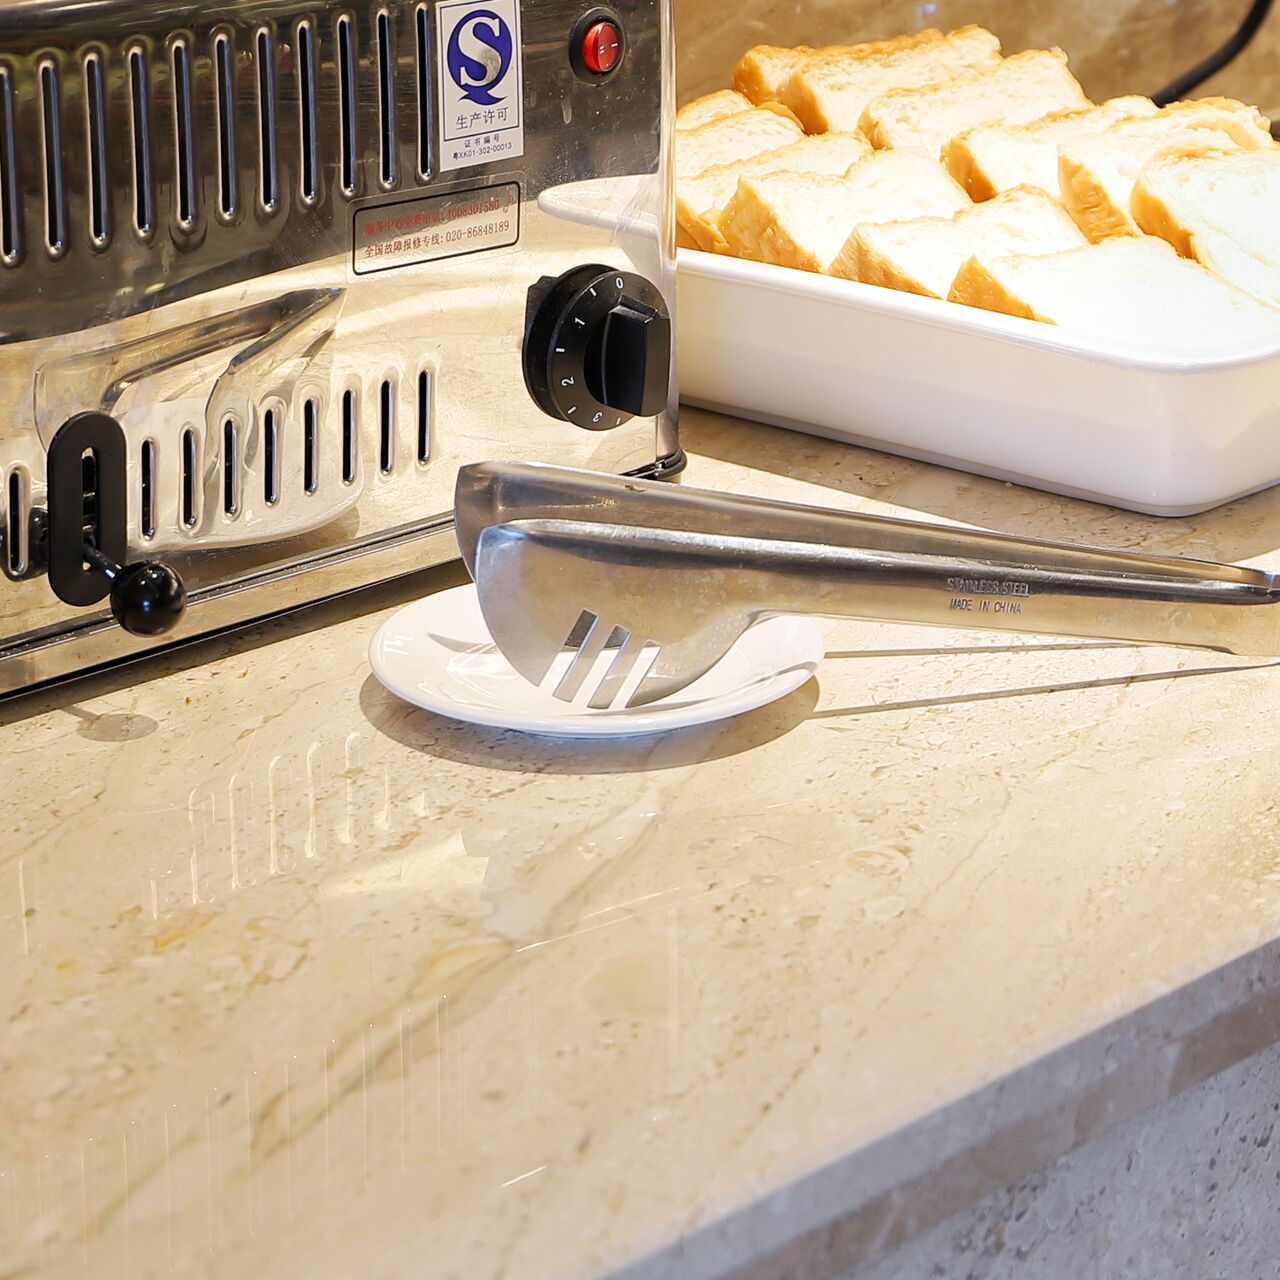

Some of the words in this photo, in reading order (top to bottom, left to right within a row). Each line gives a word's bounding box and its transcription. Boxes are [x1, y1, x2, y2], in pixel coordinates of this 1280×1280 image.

[456, 106, 509, 131] 生产许可
[615, 277, 625, 289] 0
[574, 318, 586, 327] 1
[561, 376, 575, 387] 2
[592, 412, 603, 422] 3
[947, 577, 999, 595] STAINLESS
[1002, 581, 1030, 597] STEEL
[950, 598, 973, 611] MADE
[979, 600, 990, 612] IN
[994, 601, 1022, 614] CHINA
